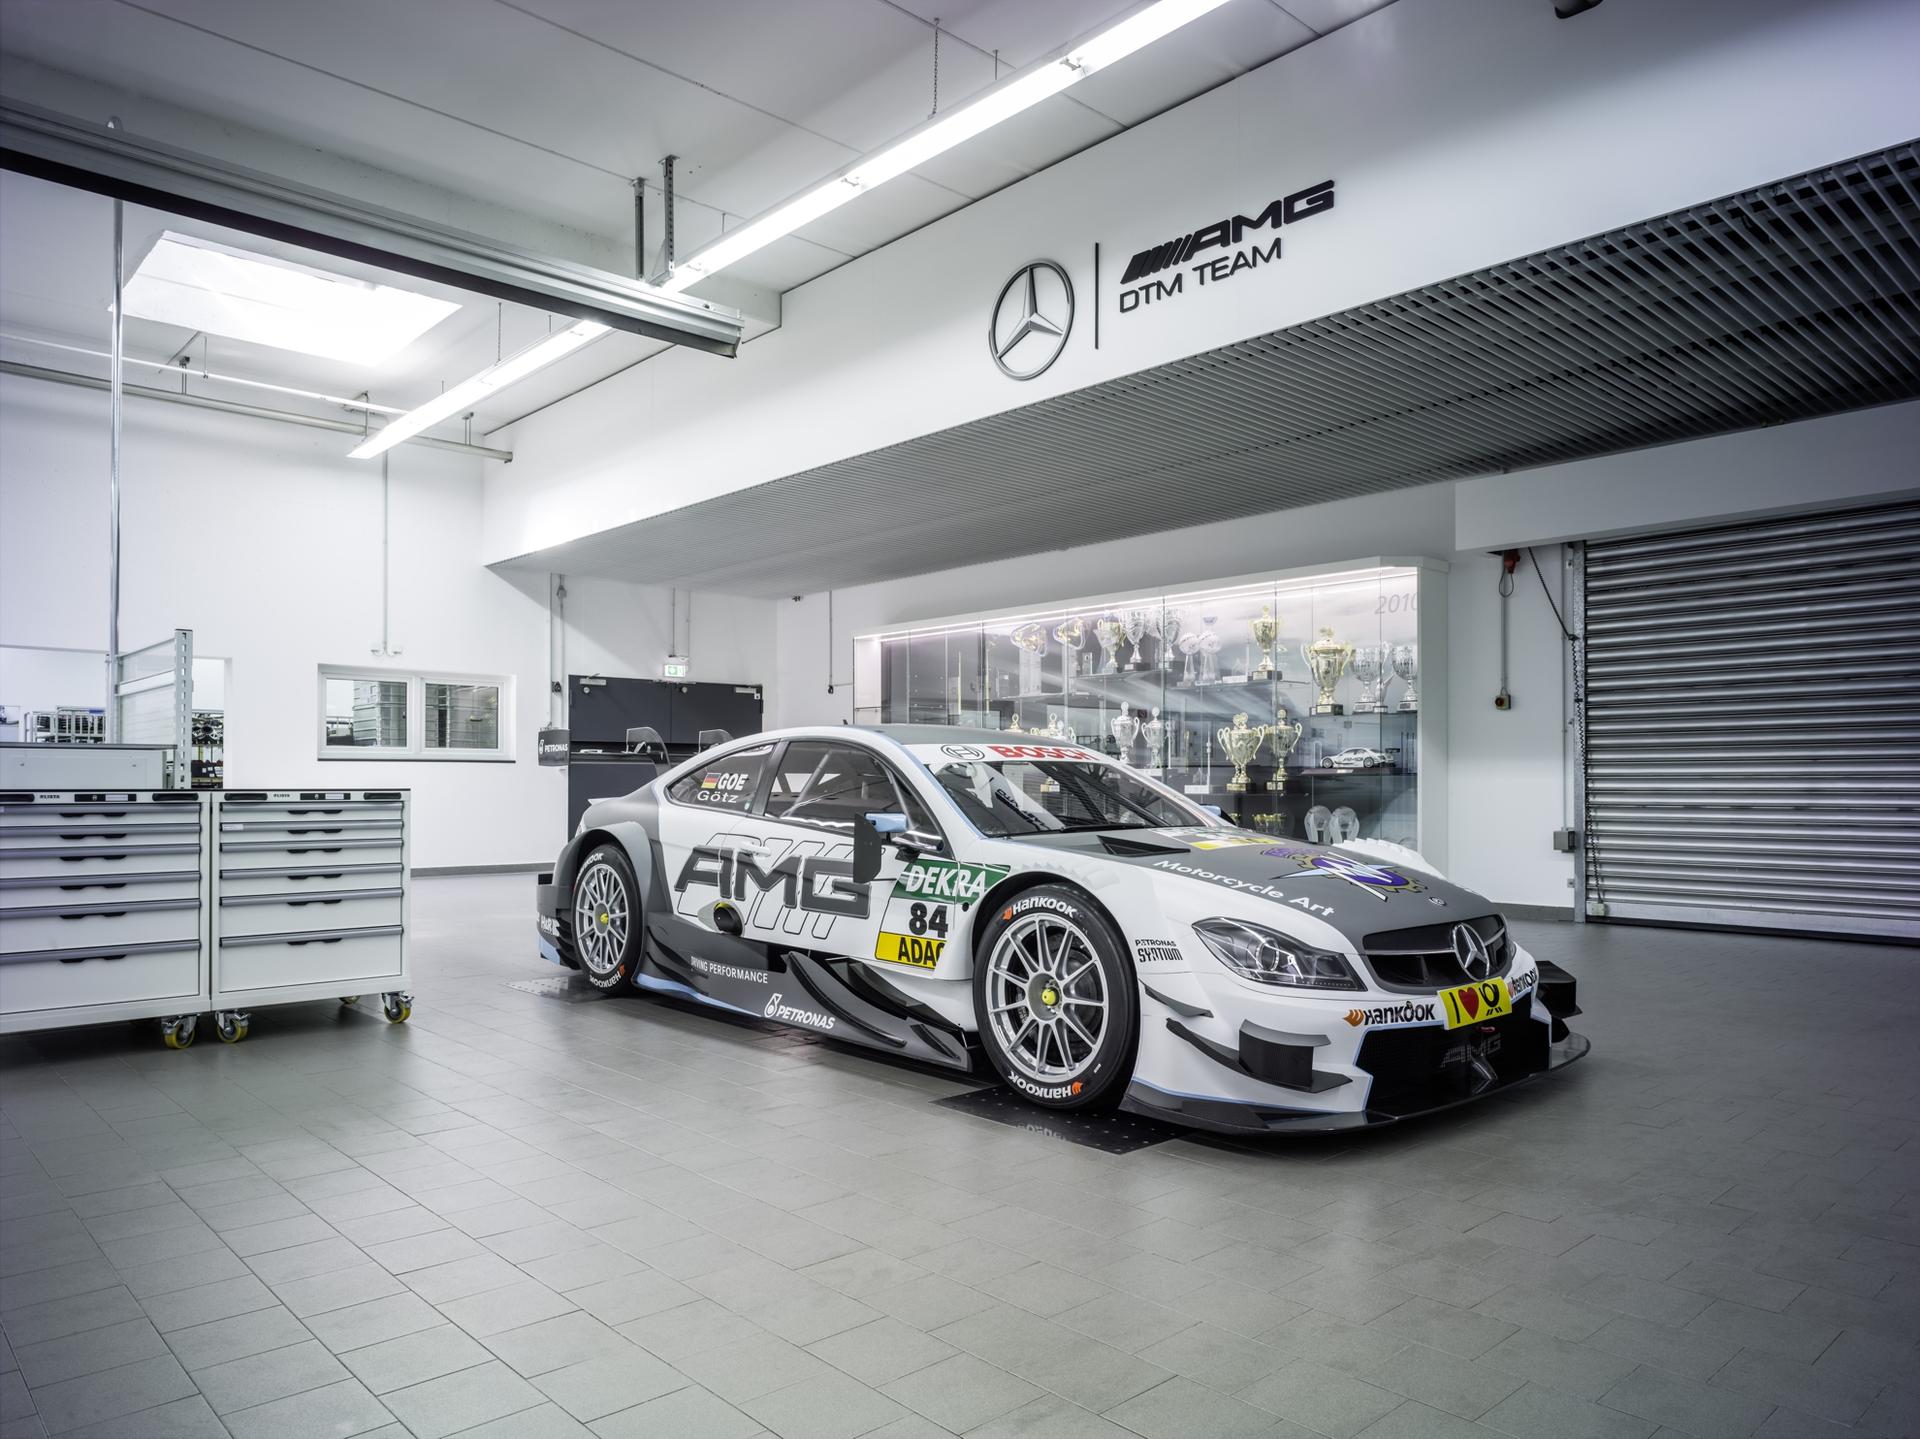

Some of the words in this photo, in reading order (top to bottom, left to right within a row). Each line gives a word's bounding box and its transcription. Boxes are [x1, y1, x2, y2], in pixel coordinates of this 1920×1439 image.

[1119, 272, 1183, 314] DTM
[1192, 237, 1282, 286] TEAM
[544, 743, 569, 753] PETRONAS
[988, 745, 1101, 761] BOSCH
[717, 772, 749, 791] GOE
[697, 790, 739, 804] Götz
[674, 845, 873, 920] AMG
[905, 864, 986, 898] DEKRA
[1152, 860, 1285, 899] Motorcycle
[1289, 896, 1336, 917] Art
[908, 902, 949, 939] 84
[1135, 939, 1177, 947] PETRONAS
[1137, 947, 1184, 963] SYNTIUM
[709, 962, 769, 984] PERFORMANCE
[776, 1004, 836, 1030] PETRONAS
[1448, 991, 1461, 1024] I
